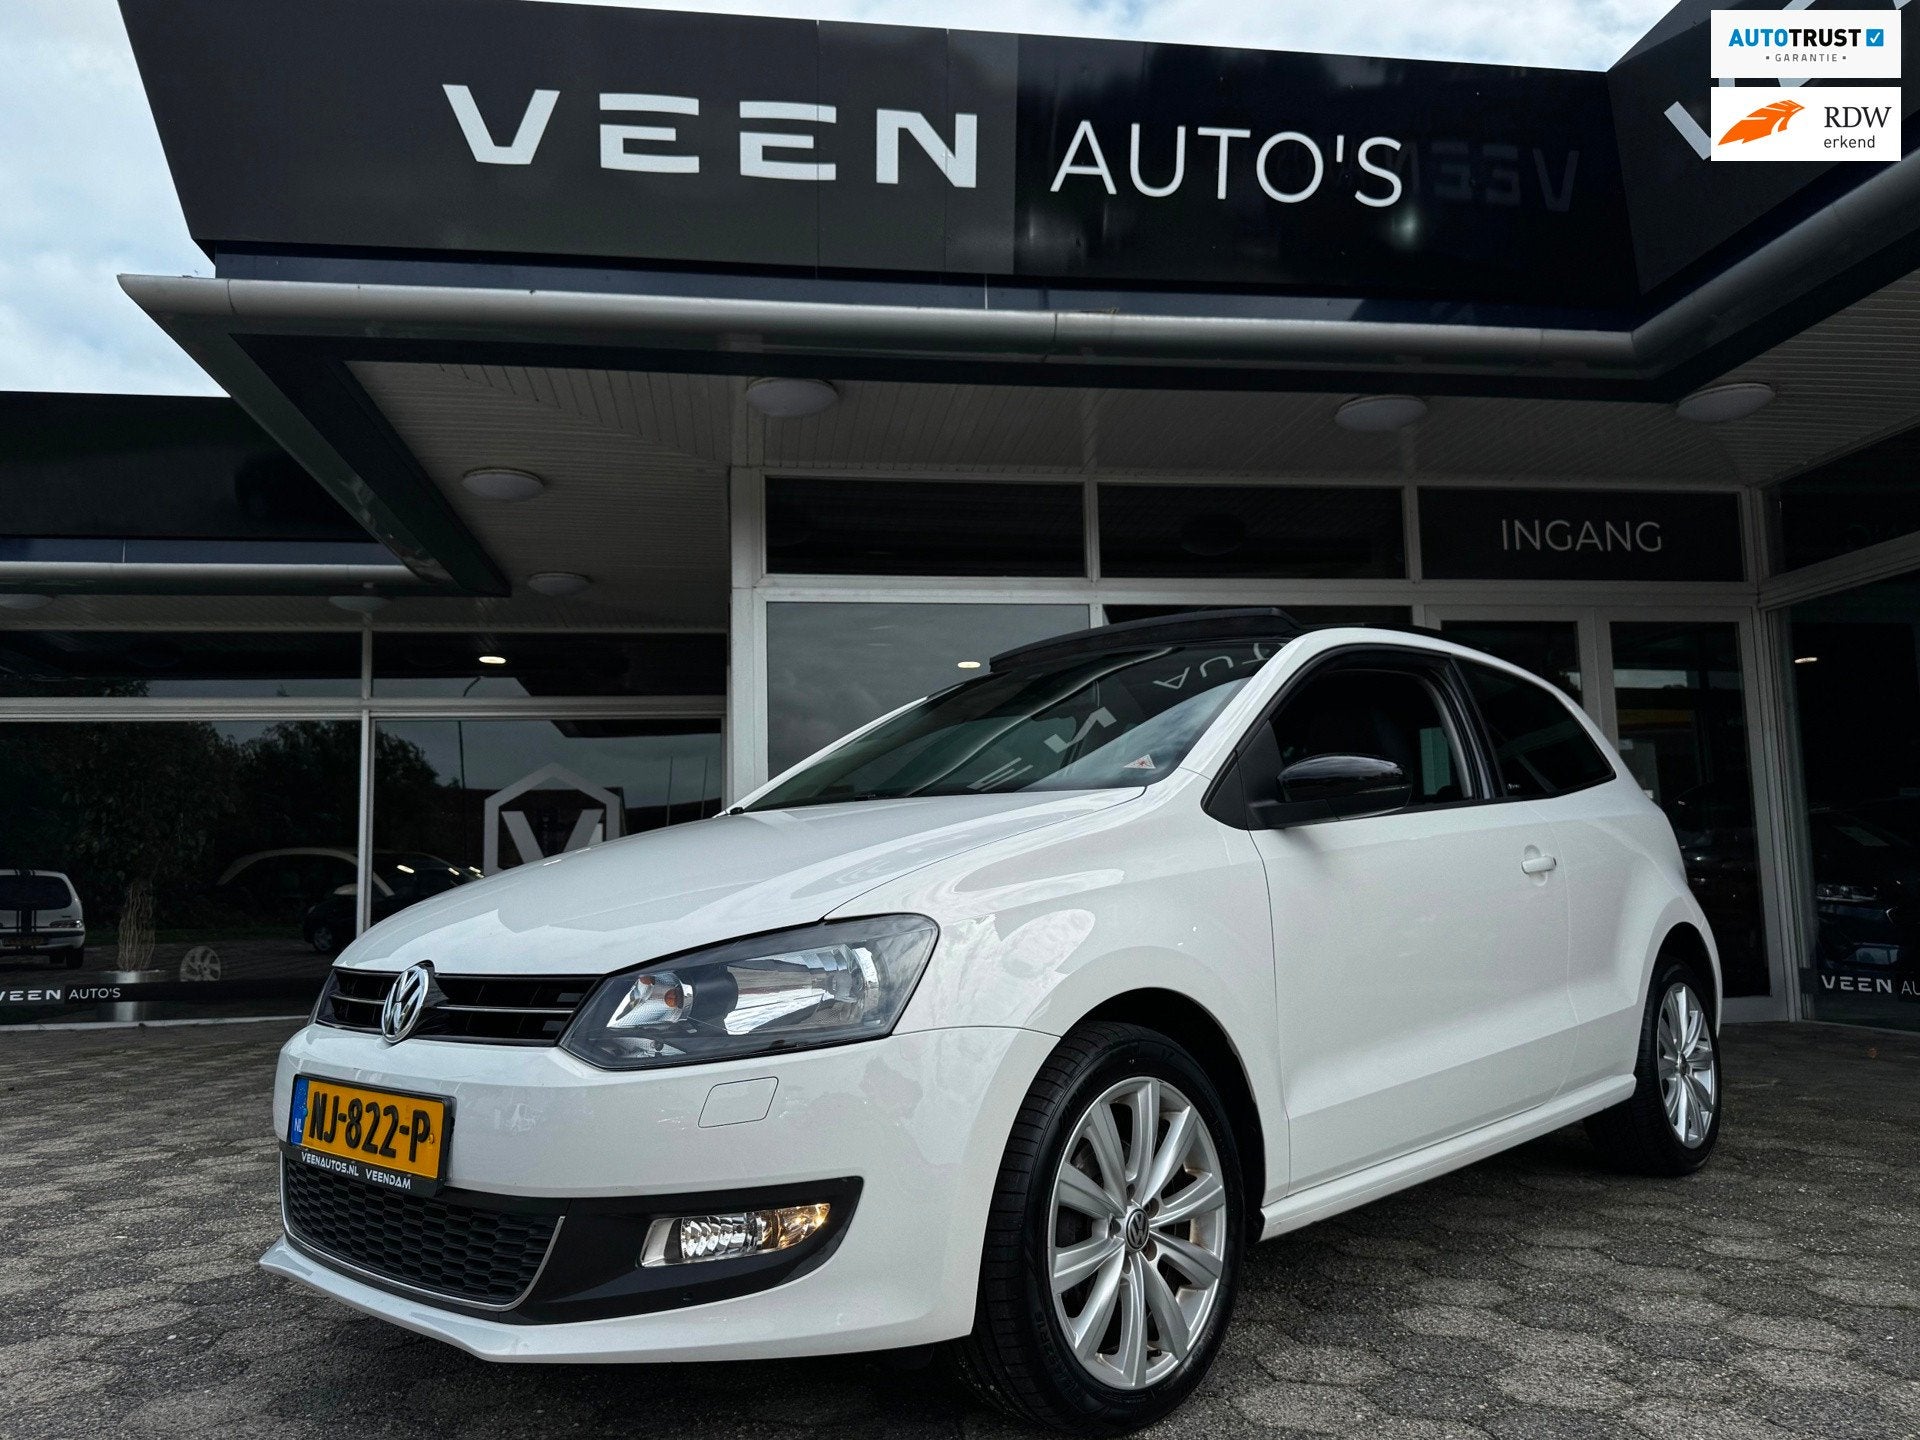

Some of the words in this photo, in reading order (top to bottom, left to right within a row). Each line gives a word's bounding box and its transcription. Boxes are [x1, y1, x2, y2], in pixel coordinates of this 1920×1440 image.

[442, 84, 978, 189] VEEN
[1050, 120, 1402, 207] AUTO'S
[1501, 519, 1662, 552] INGANG
[69, 987, 121, 1000] AUTO'S
[1821, 975, 1892, 994] VEEN
[308, 1091, 432, 1163] NJ-822-P
[301, 1151, 360, 1177] VEENAUTOS.NL
[365, 1168, 411, 1190] VEENDAM
